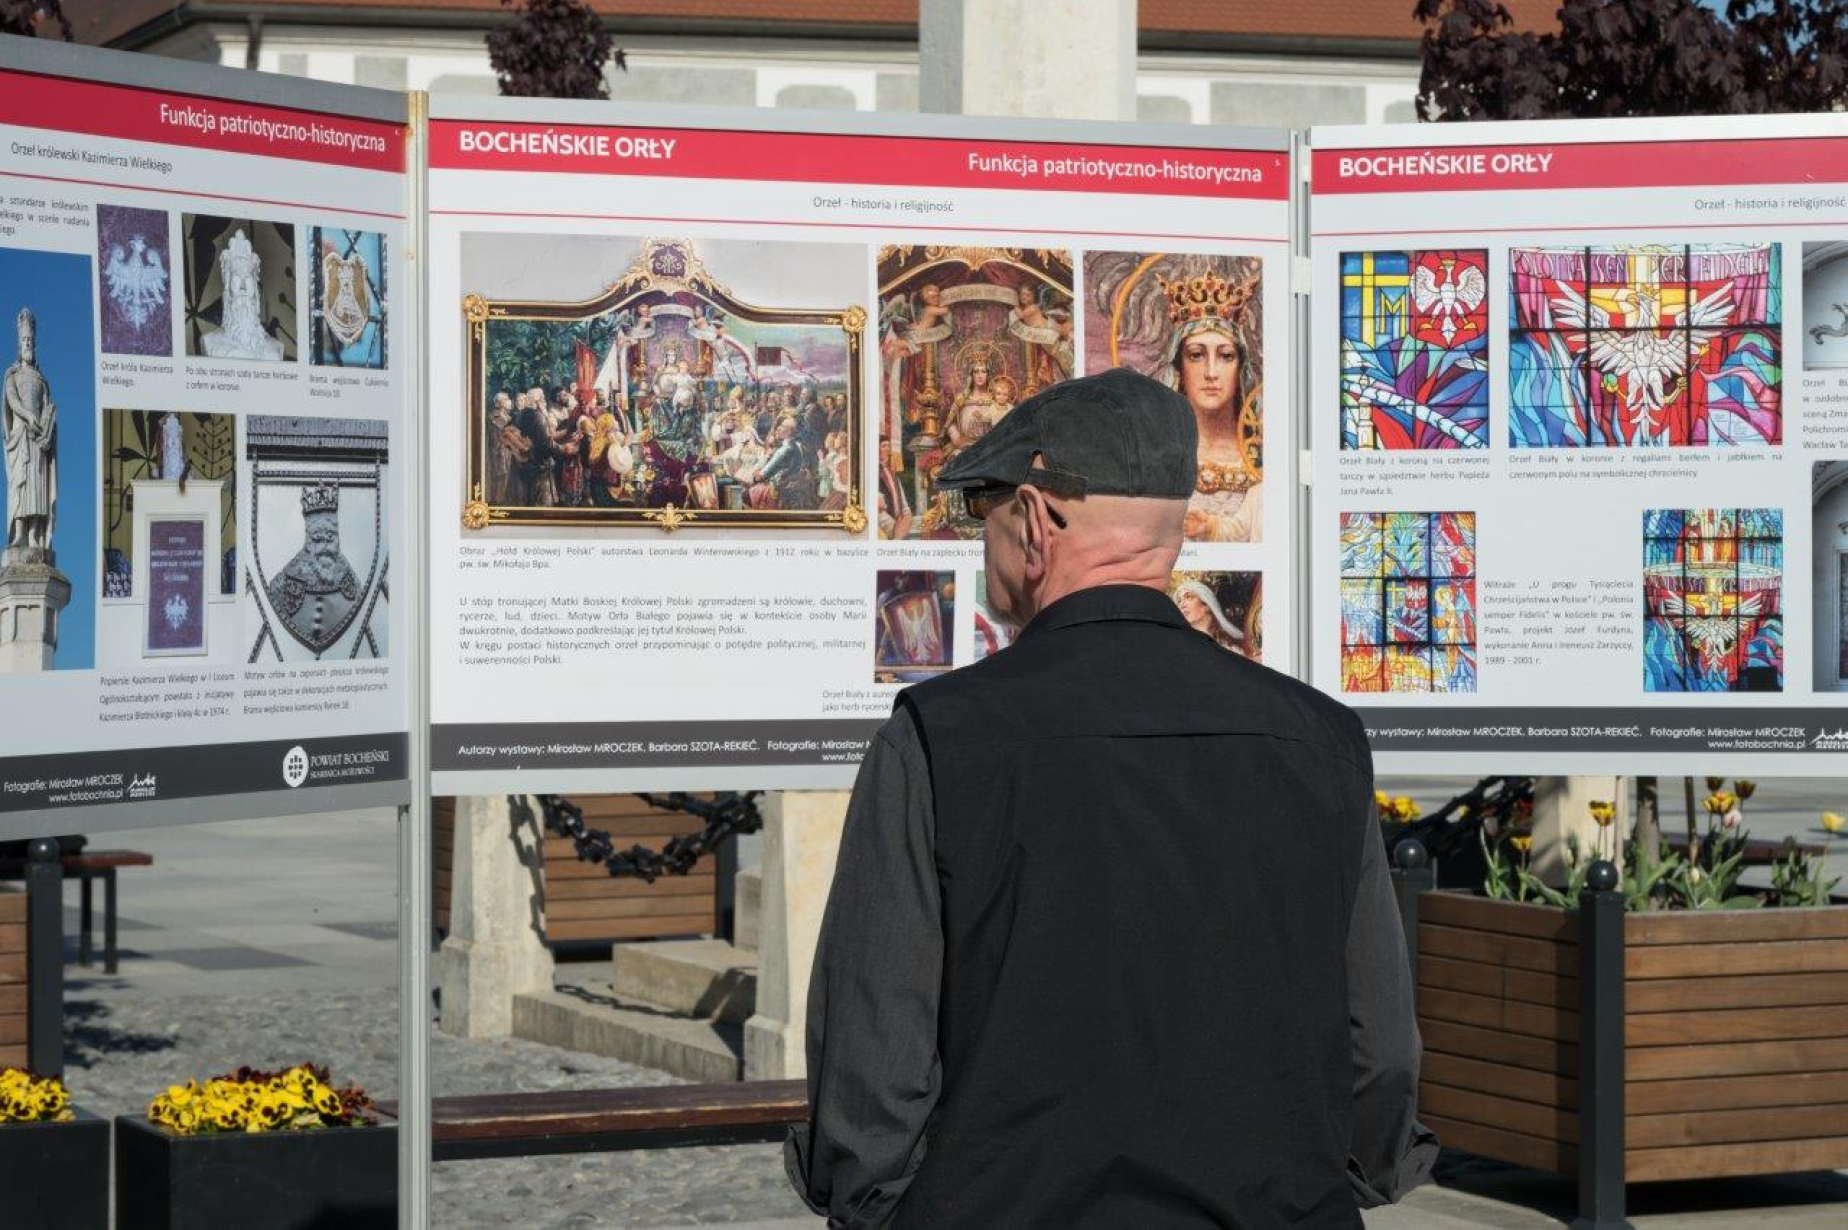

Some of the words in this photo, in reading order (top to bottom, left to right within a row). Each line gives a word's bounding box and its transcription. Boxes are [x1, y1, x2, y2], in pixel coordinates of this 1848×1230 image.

[160, 104, 216, 132] Funkcja
[220, 116, 385, 152] patriotyczno-historyczna
[459, 129, 610, 155] BOCHEŃSKIE
[614, 137, 675, 158] ORŁY
[11, 142, 36, 156] Orzeł
[37, 146, 80, 161] królewski
[81, 151, 128, 167] Kazimierza
[129, 157, 172, 174] Wielkiego
[1339, 152, 1485, 176] BOCHEŃSKIE
[1491, 153, 1552, 173] ORŁY
[969, 153, 1038, 176] Funkcja
[1043, 160, 1262, 182] patriotyczno-historyczna
[813, 197, 842, 208] Orzeł
[851, 198, 892, 210] historia
[900, 200, 954, 213] religijność
[1694, 199, 1725, 210] Orzeł
[1735, 198, 1778, 209] historia
[1787, 196, 1847, 210] religijność
[459, 546, 486, 555] Obraz
[523, 547, 561, 556] Królowej
[649, 548, 688, 556] Leonarda
[693, 548, 760, 557] Winterowskiego
[775, 547, 795, 556] 1912
[836, 548, 869, 556] bazylice
[471, 597, 493, 608] stóp
[497, 598, 547, 608] tronującej
[551, 597, 579, 606] Matki
[582, 597, 617, 607] Boskiej
[621, 597, 662, 607] Królowej
[666, 596, 693, 606] Polski
[697, 597, 756, 608] zgromadzeni
[759, 599, 770, 608] są
[773, 597, 816, 606] królowie,
[819, 596, 867, 606] duchowni,
[459, 613, 497, 622] rycerze,
[504, 611, 523, 621] lud,
[530, 612, 560, 621] dzieci.
[567, 612, 602, 622] Motyw
[608, 611, 629, 620] Orła
[636, 611, 671, 622] Białego
[676, 611, 714, 621] pojawia
[719, 611, 733, 622] się
[754, 611, 803, 620] kontekście
[809, 611, 836, 621] osoby
[842, 611, 867, 620] Marii
[459, 626, 518, 636] dwukrotnie,
[520, 626, 574, 635] dodatkowo
[576, 626, 635, 636] podkreślając
[637, 626, 650, 636] jej
[651, 626, 674, 636] tytuł
[675, 626, 717, 636] Królowej
[718, 625, 747, 634] Polski.
[475, 641, 503, 652] kręgu
[507, 641, 542, 651] postaci
[546, 641, 610, 650] historycznych
[614, 640, 639, 649] orzeł
[642, 641, 710, 650] przypominając
[725, 640, 763, 650] potędze
[766, 640, 818, 650] politycznej,
[822, 640, 866, 649] militarnej
[464, 656, 531, 665] suwerenności
[533, 654, 562, 664] Polski.
[1484, 656, 1506, 665] 1989
[1513, 656, 1533, 664] 2001
[1379, 728, 1425, 737] wystawy:
[1427, 728, 1471, 736] Mirosław
[1473, 727, 1525, 736] MROCZEK,
[1527, 727, 1568, 736] Barbara
[1650, 727, 1705, 738] Fotografie:
[1707, 728, 1753, 737] Mirosław
[1755, 728, 1805, 737] MROCZEK
[458, 746, 497, 755] Autorzy
[498, 745, 545, 755] wystawy:
[547, 744, 592, 753] Mirosław
[594, 742, 646, 753] MROCZEK,
[648, 742, 688, 752] Barbara
[767, 741, 819, 751] Fotografie:
[821, 741, 864, 749] Mirosław
[1708, 740, 1806, 748] www.fotobochnia.pl
[3, 780, 47, 794] Fotografie:
[49, 776, 85, 790] Mirosław
[85, 773, 124, 787] MROCZEK
